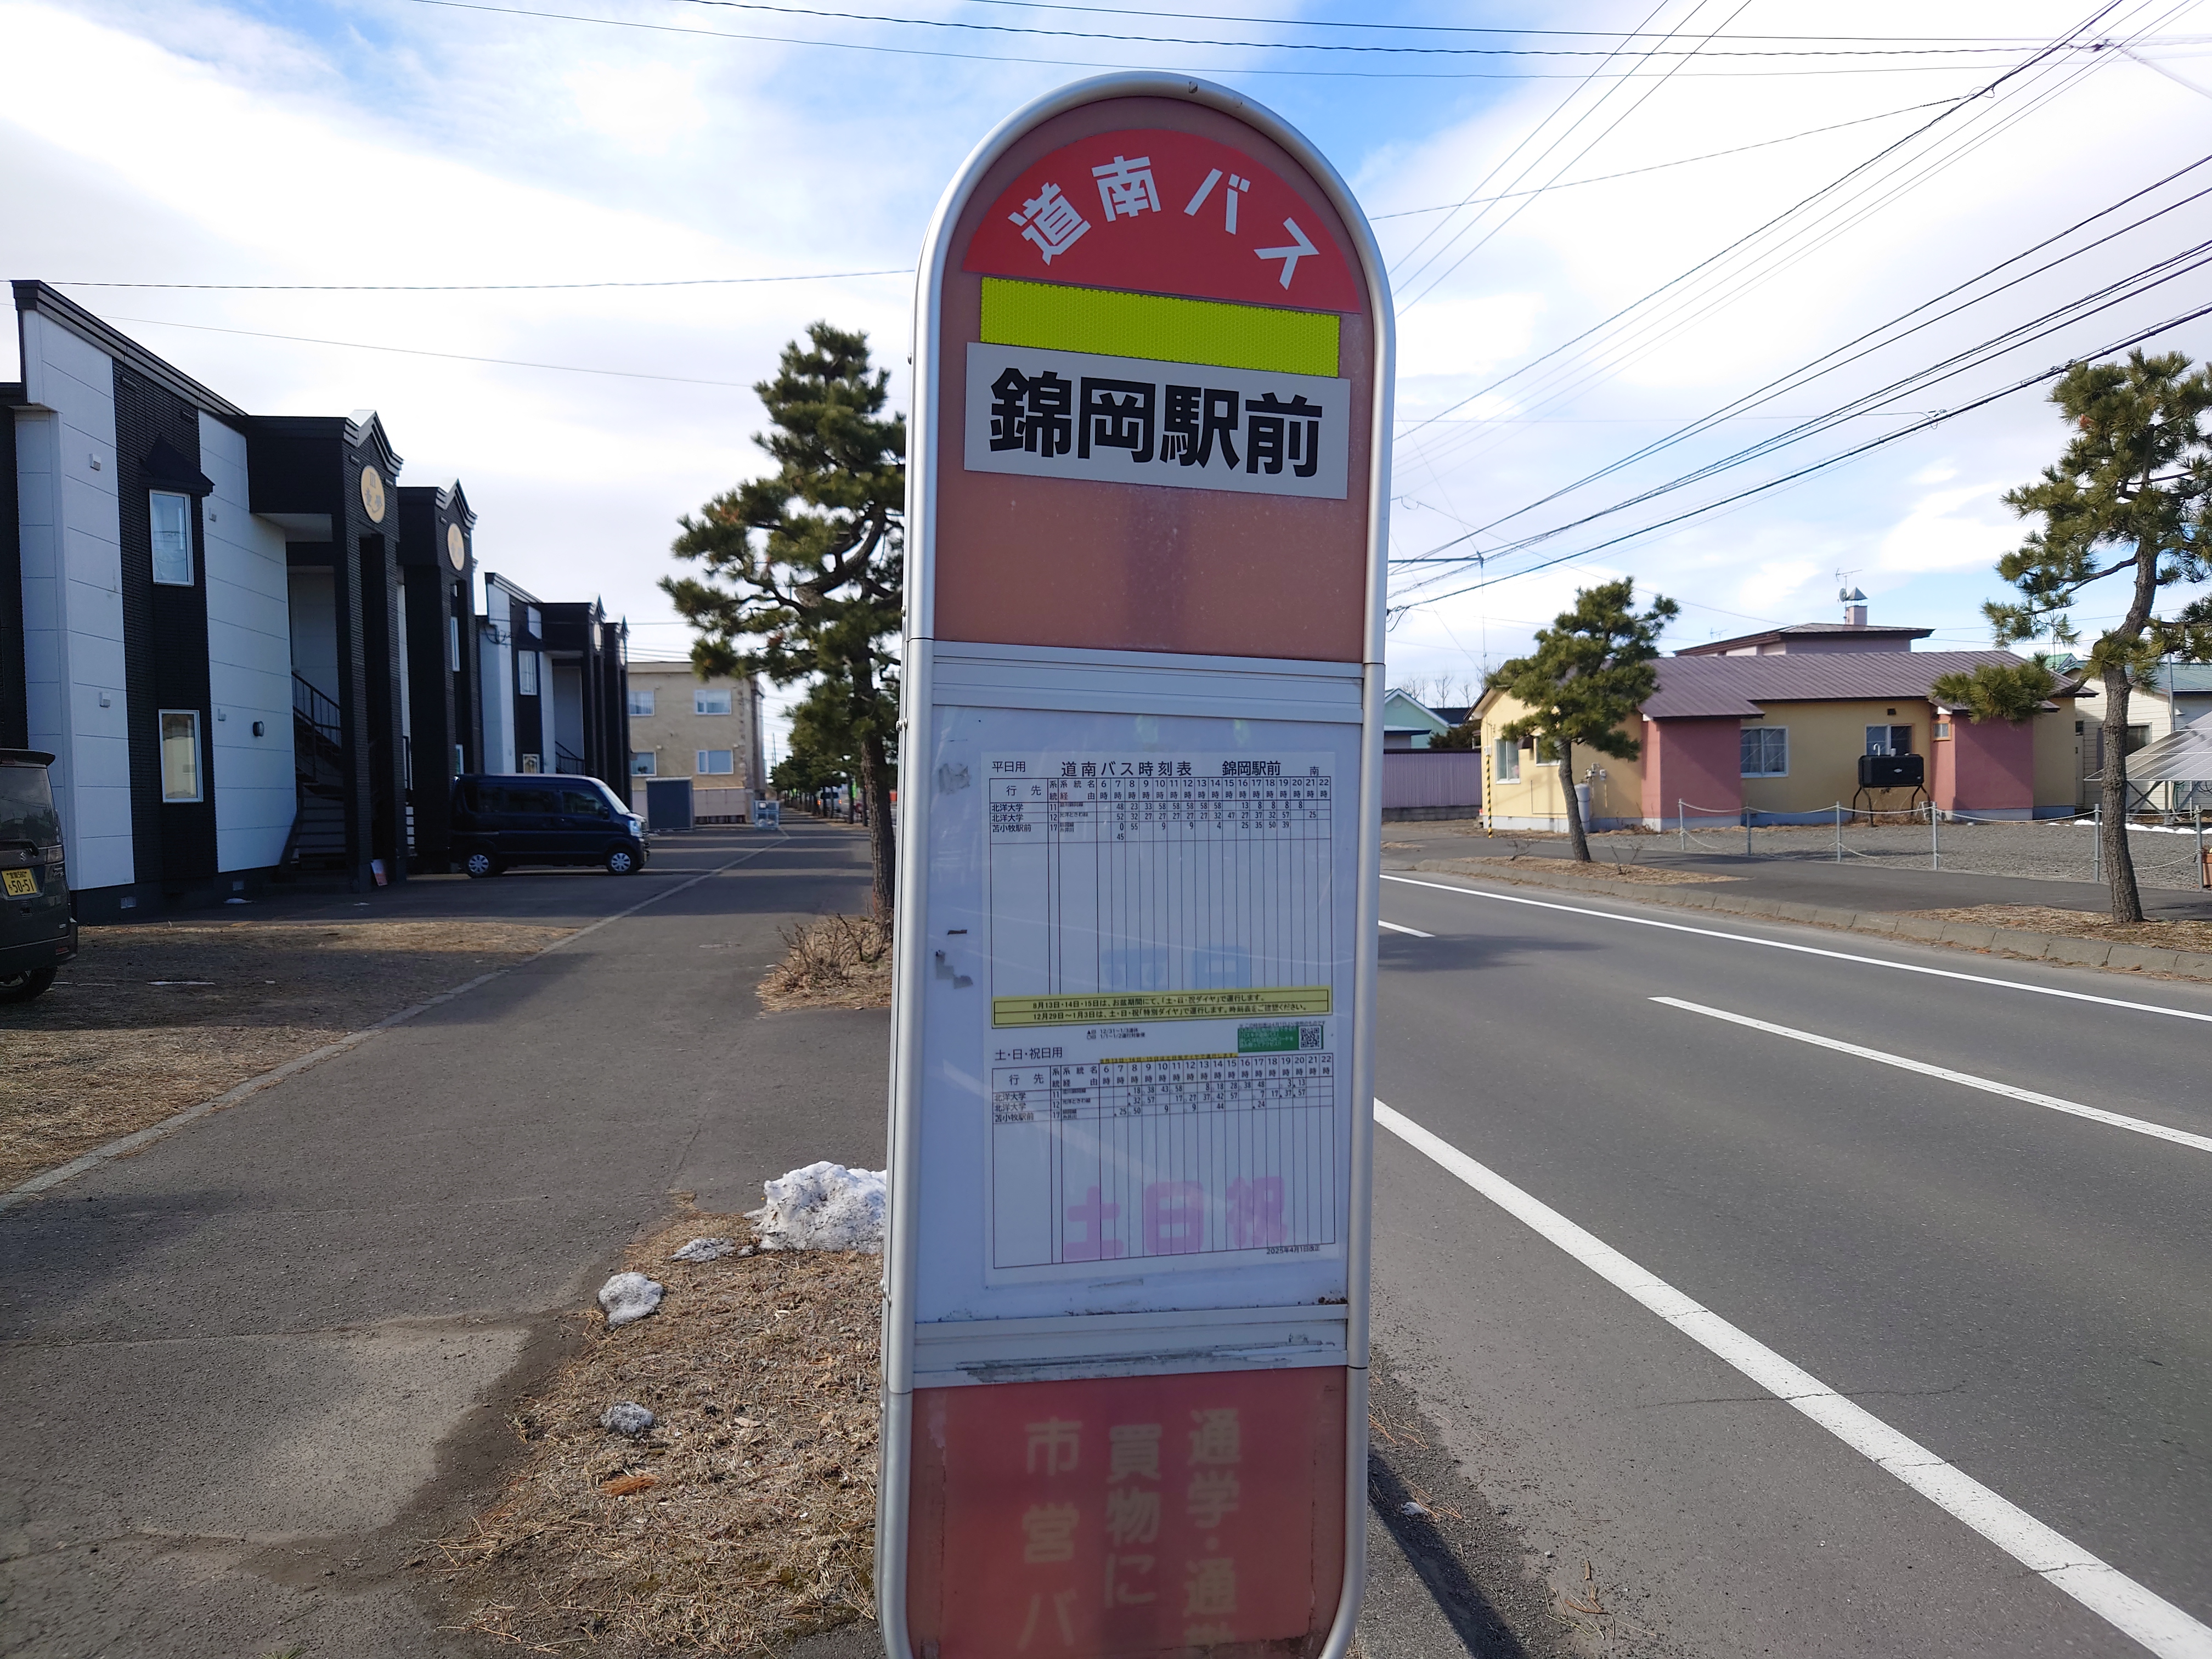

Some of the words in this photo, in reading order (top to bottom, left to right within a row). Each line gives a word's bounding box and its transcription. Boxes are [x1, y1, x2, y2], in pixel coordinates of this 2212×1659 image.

[1008, 155, 1320, 290] 道南バス
[990, 368, 1323, 478] 錦岡駅前
[992, 761, 1025, 772] 平日用
[1061, 761, 1192, 777] 道南バス時刻表
[1222, 761, 1280, 776] 錦岡駅前
[1310, 766, 1319, 776] 南
[992, 824, 1031, 832] 苫小牧駅前
[995, 1047, 1062, 1060] 土・日・祝日用
[995, 1092, 1026, 1102] 北洋大学
[995, 1103, 1026, 1111] 北洋大学
[995, 1113, 1034, 1122] 苫小牧駅前
[1104, 1423, 1162, 1609] 買物に
[1018, 1416, 1084, 1651] 市営バ
